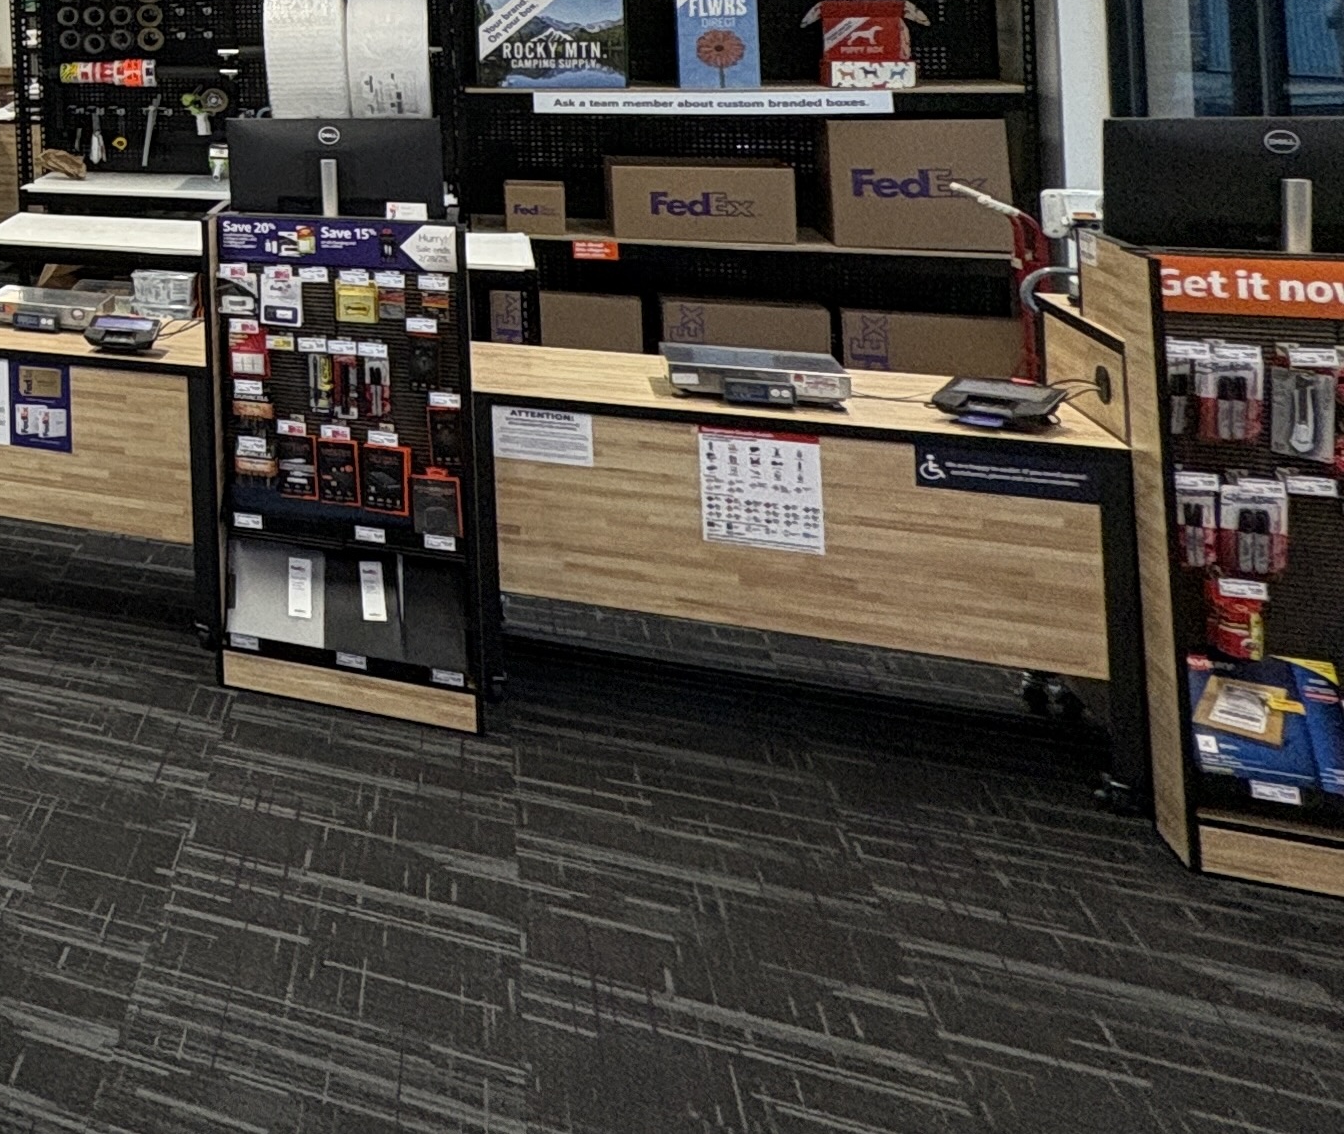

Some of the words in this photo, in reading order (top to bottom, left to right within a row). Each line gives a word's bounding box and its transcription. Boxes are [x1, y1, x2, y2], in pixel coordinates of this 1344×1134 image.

[482, 17, 503, 35] Your
[487, 32, 503, 44] On
[502, 16, 520, 34] your
[502, 42, 556, 59] ROCKY
[565, 42, 607, 59] MTN.
[511, 59, 555, 69] CAMPING
[553, 98, 575, 107] Ask
[590, 99, 619, 107] team
[622, 99, 673, 108] member
[677, 99, 714, 108] about
[717, 100, 764, 108] custom
[768, 99, 822, 108] branded
[826, 98, 869, 107] boxes.
[650, 191, 755, 218] FedEx
[222, 221, 252, 233] Save
[320, 227, 352, 239] Save
[1162, 268, 1229, 298] Get
[1236, 270, 1270, 301] it
